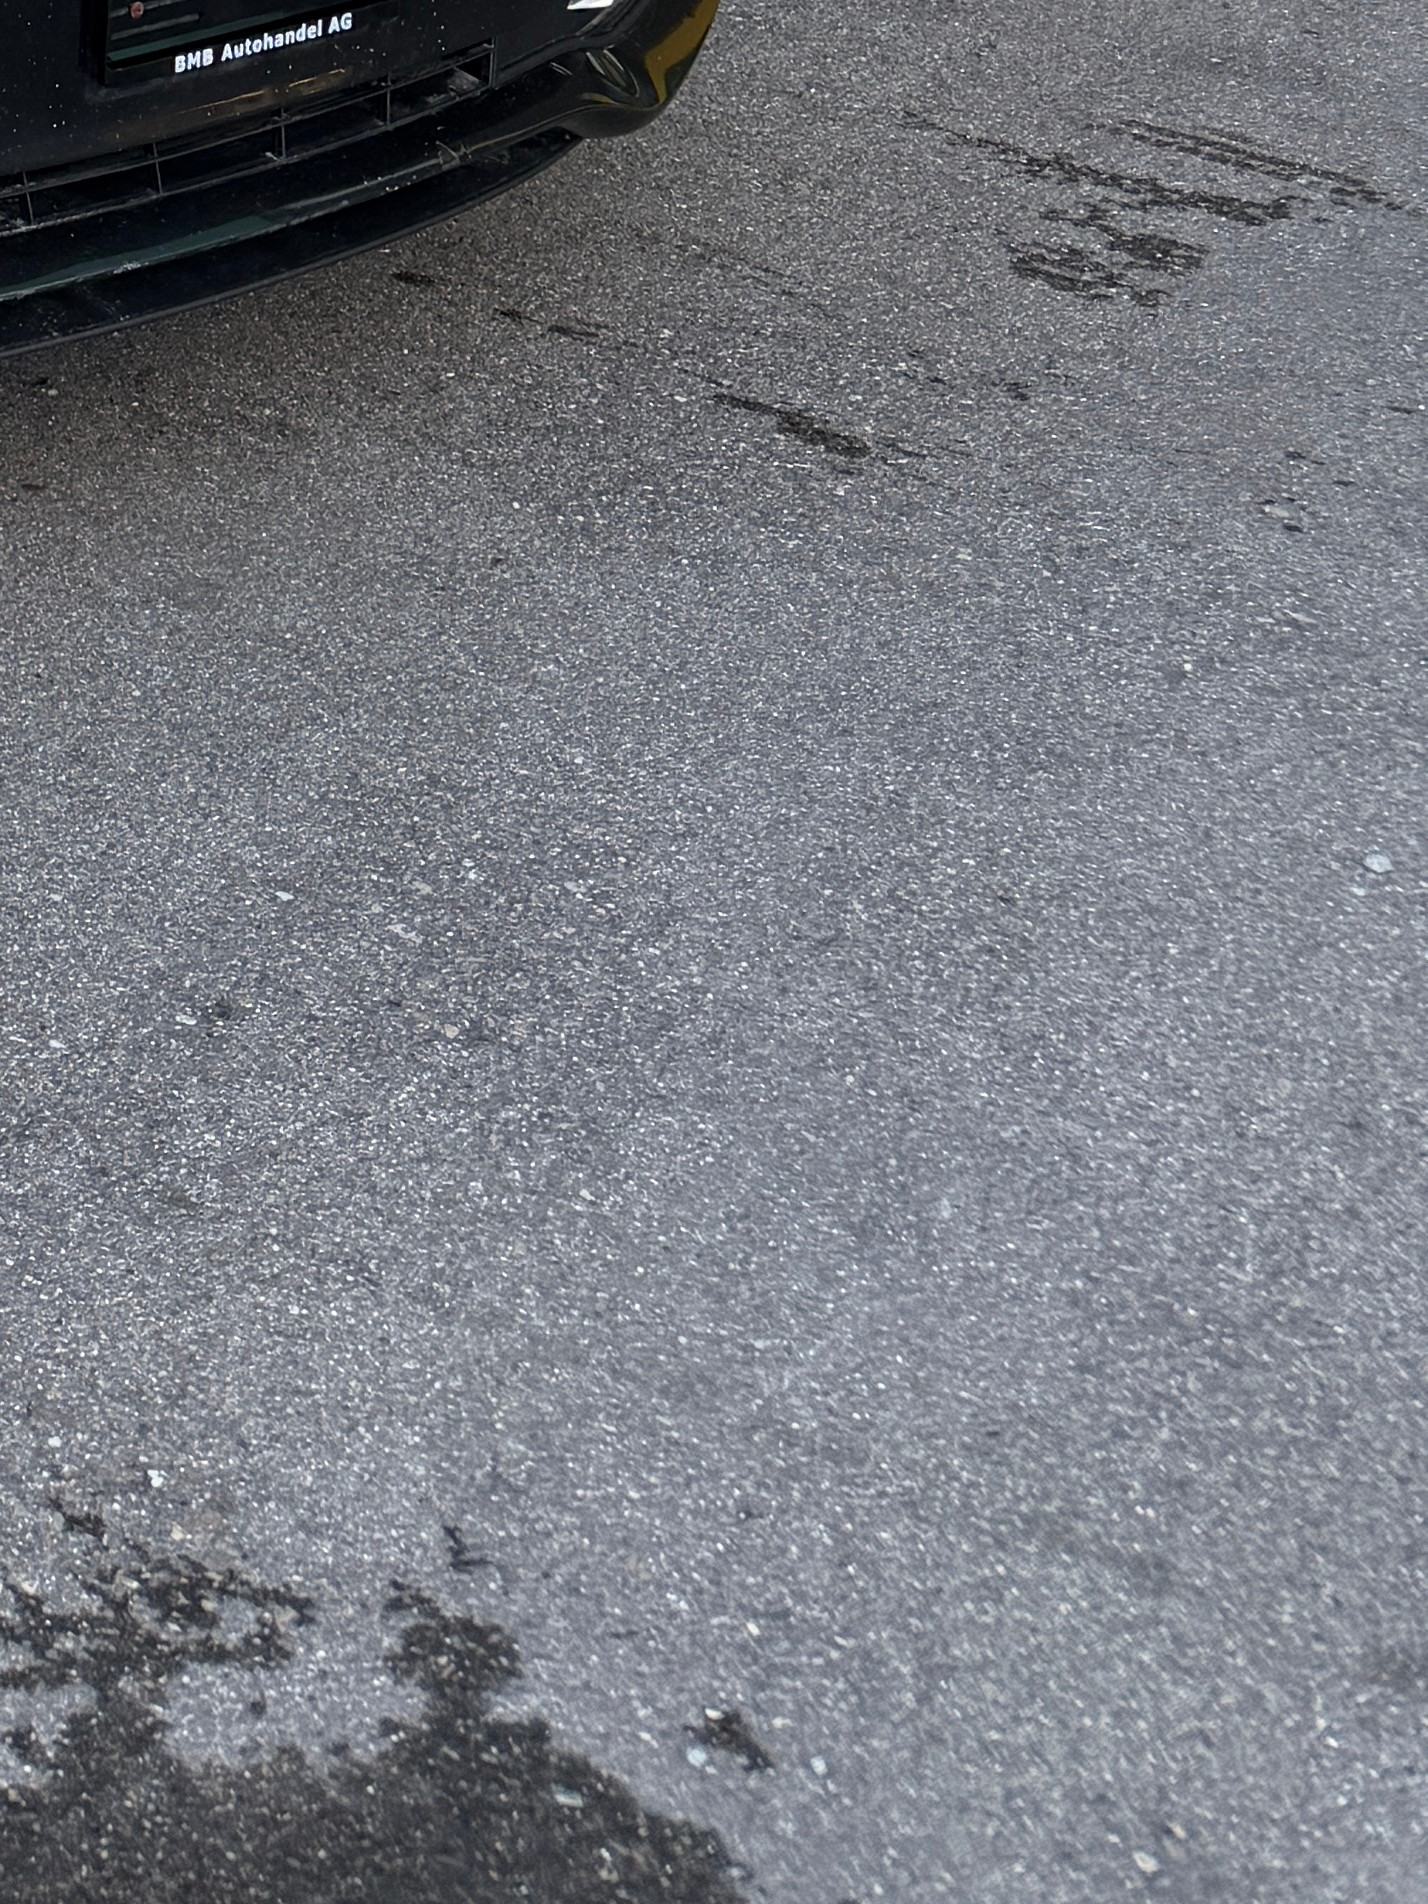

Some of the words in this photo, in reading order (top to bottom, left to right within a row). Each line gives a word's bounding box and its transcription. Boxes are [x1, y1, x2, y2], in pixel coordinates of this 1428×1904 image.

[174, 48, 213, 73] BMB
[221, 18, 323, 62] Autohandel
[328, 12, 353, 35] AG
